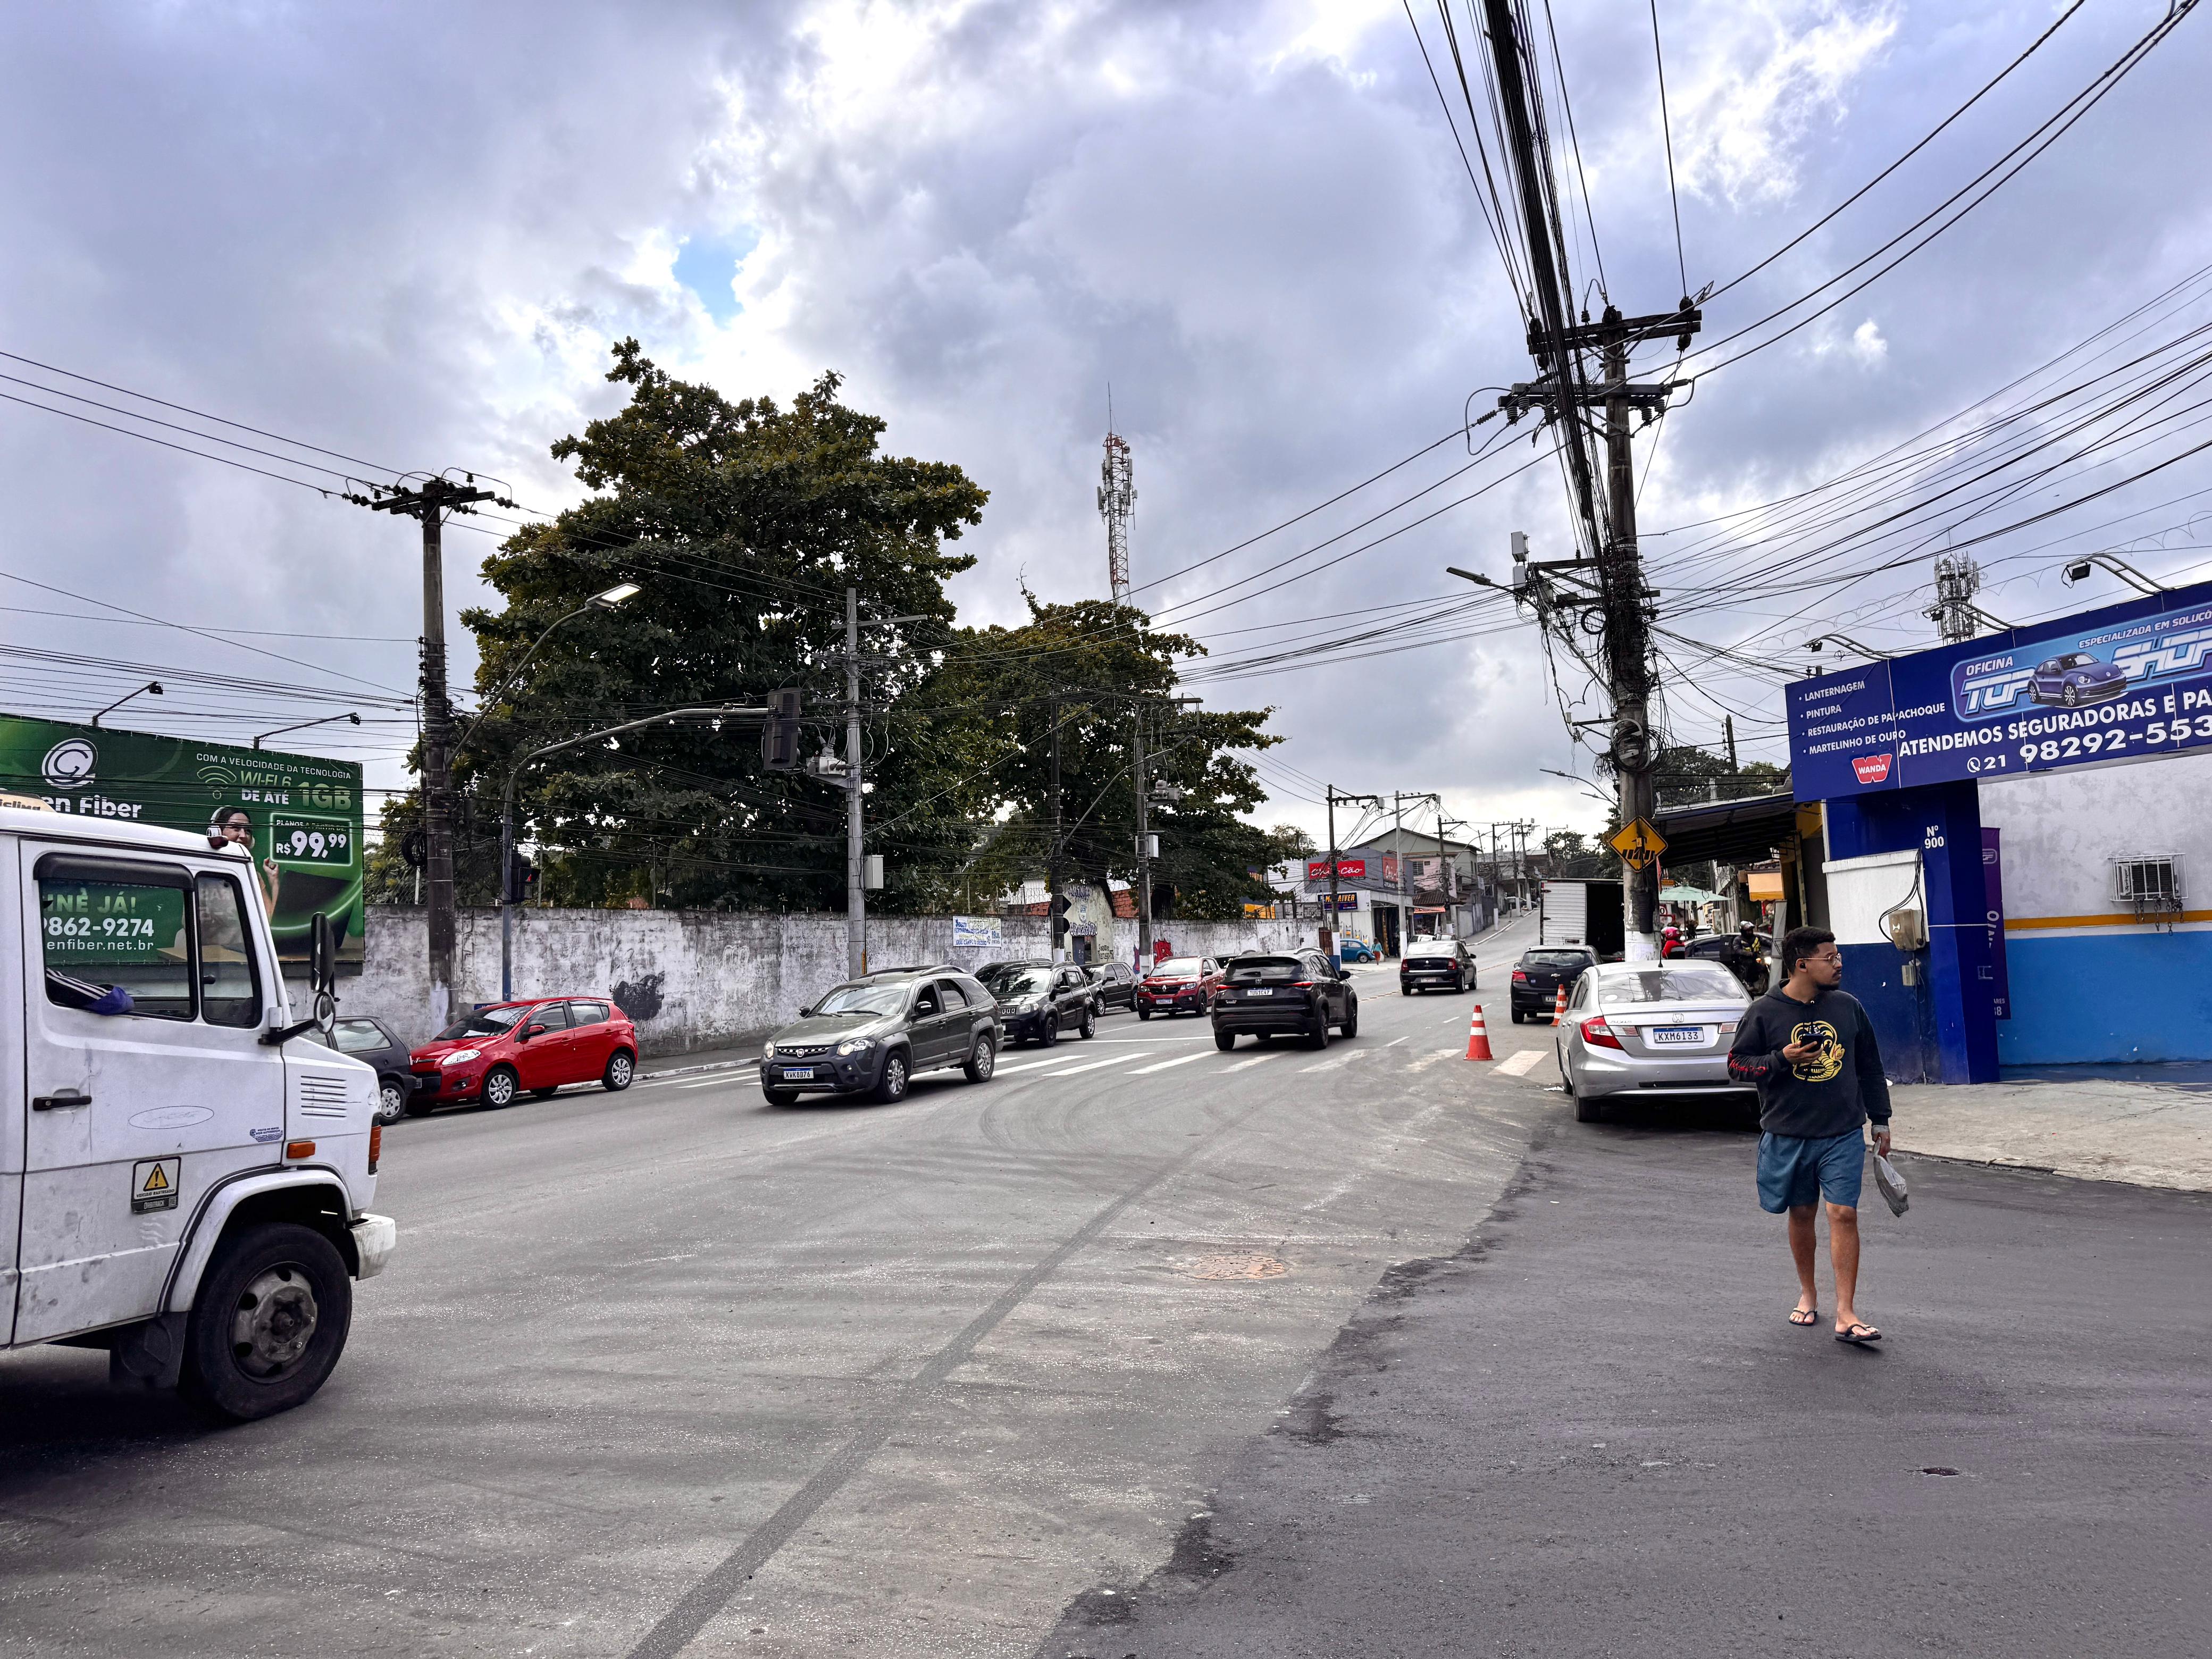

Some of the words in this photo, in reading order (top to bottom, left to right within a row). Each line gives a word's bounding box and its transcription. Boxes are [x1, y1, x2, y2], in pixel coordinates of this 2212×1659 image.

[2079, 624, 2151, 649] ESPECIALIZADA
[2154, 620, 2170, 631] EM
[1966, 656, 2014, 676] OFICINA
[1805, 681, 1865, 701] LANTERNAGEM
[1806, 705, 1842, 719] PINTURA
[1808, 718, 1865, 737] RESTAURAÇÃO
[1868, 715, 1879, 725] DE
[1899, 726, 2002, 757] ATENDEMOS
[2008, 698, 2157, 740] SEGURADORAS
[2163, 694, 2175, 713] E
[1809, 738, 1862, 755] MARTELINHO
[1865, 734, 1876, 744] DE
[197, 753, 217, 763] COM
[221, 755, 227, 763] A
[229, 757, 284, 772] VELOCIDADE
[300, 767, 351, 780] TECNOLOGIA
[1858, 764, 1886, 774] WANDA
[1983, 755, 2006, 770] 21
[241, 789, 260, 802] DE
[80, 794, 142, 818] Fiber
[276, 842, 291, 855] R$
[1924, 836, 1945, 849] 900
[97, 891, 136, 914] JÁ!
[1325, 894, 1355, 902] MAIVER
[1658, 1032, 1698, 1041] KXM6133
